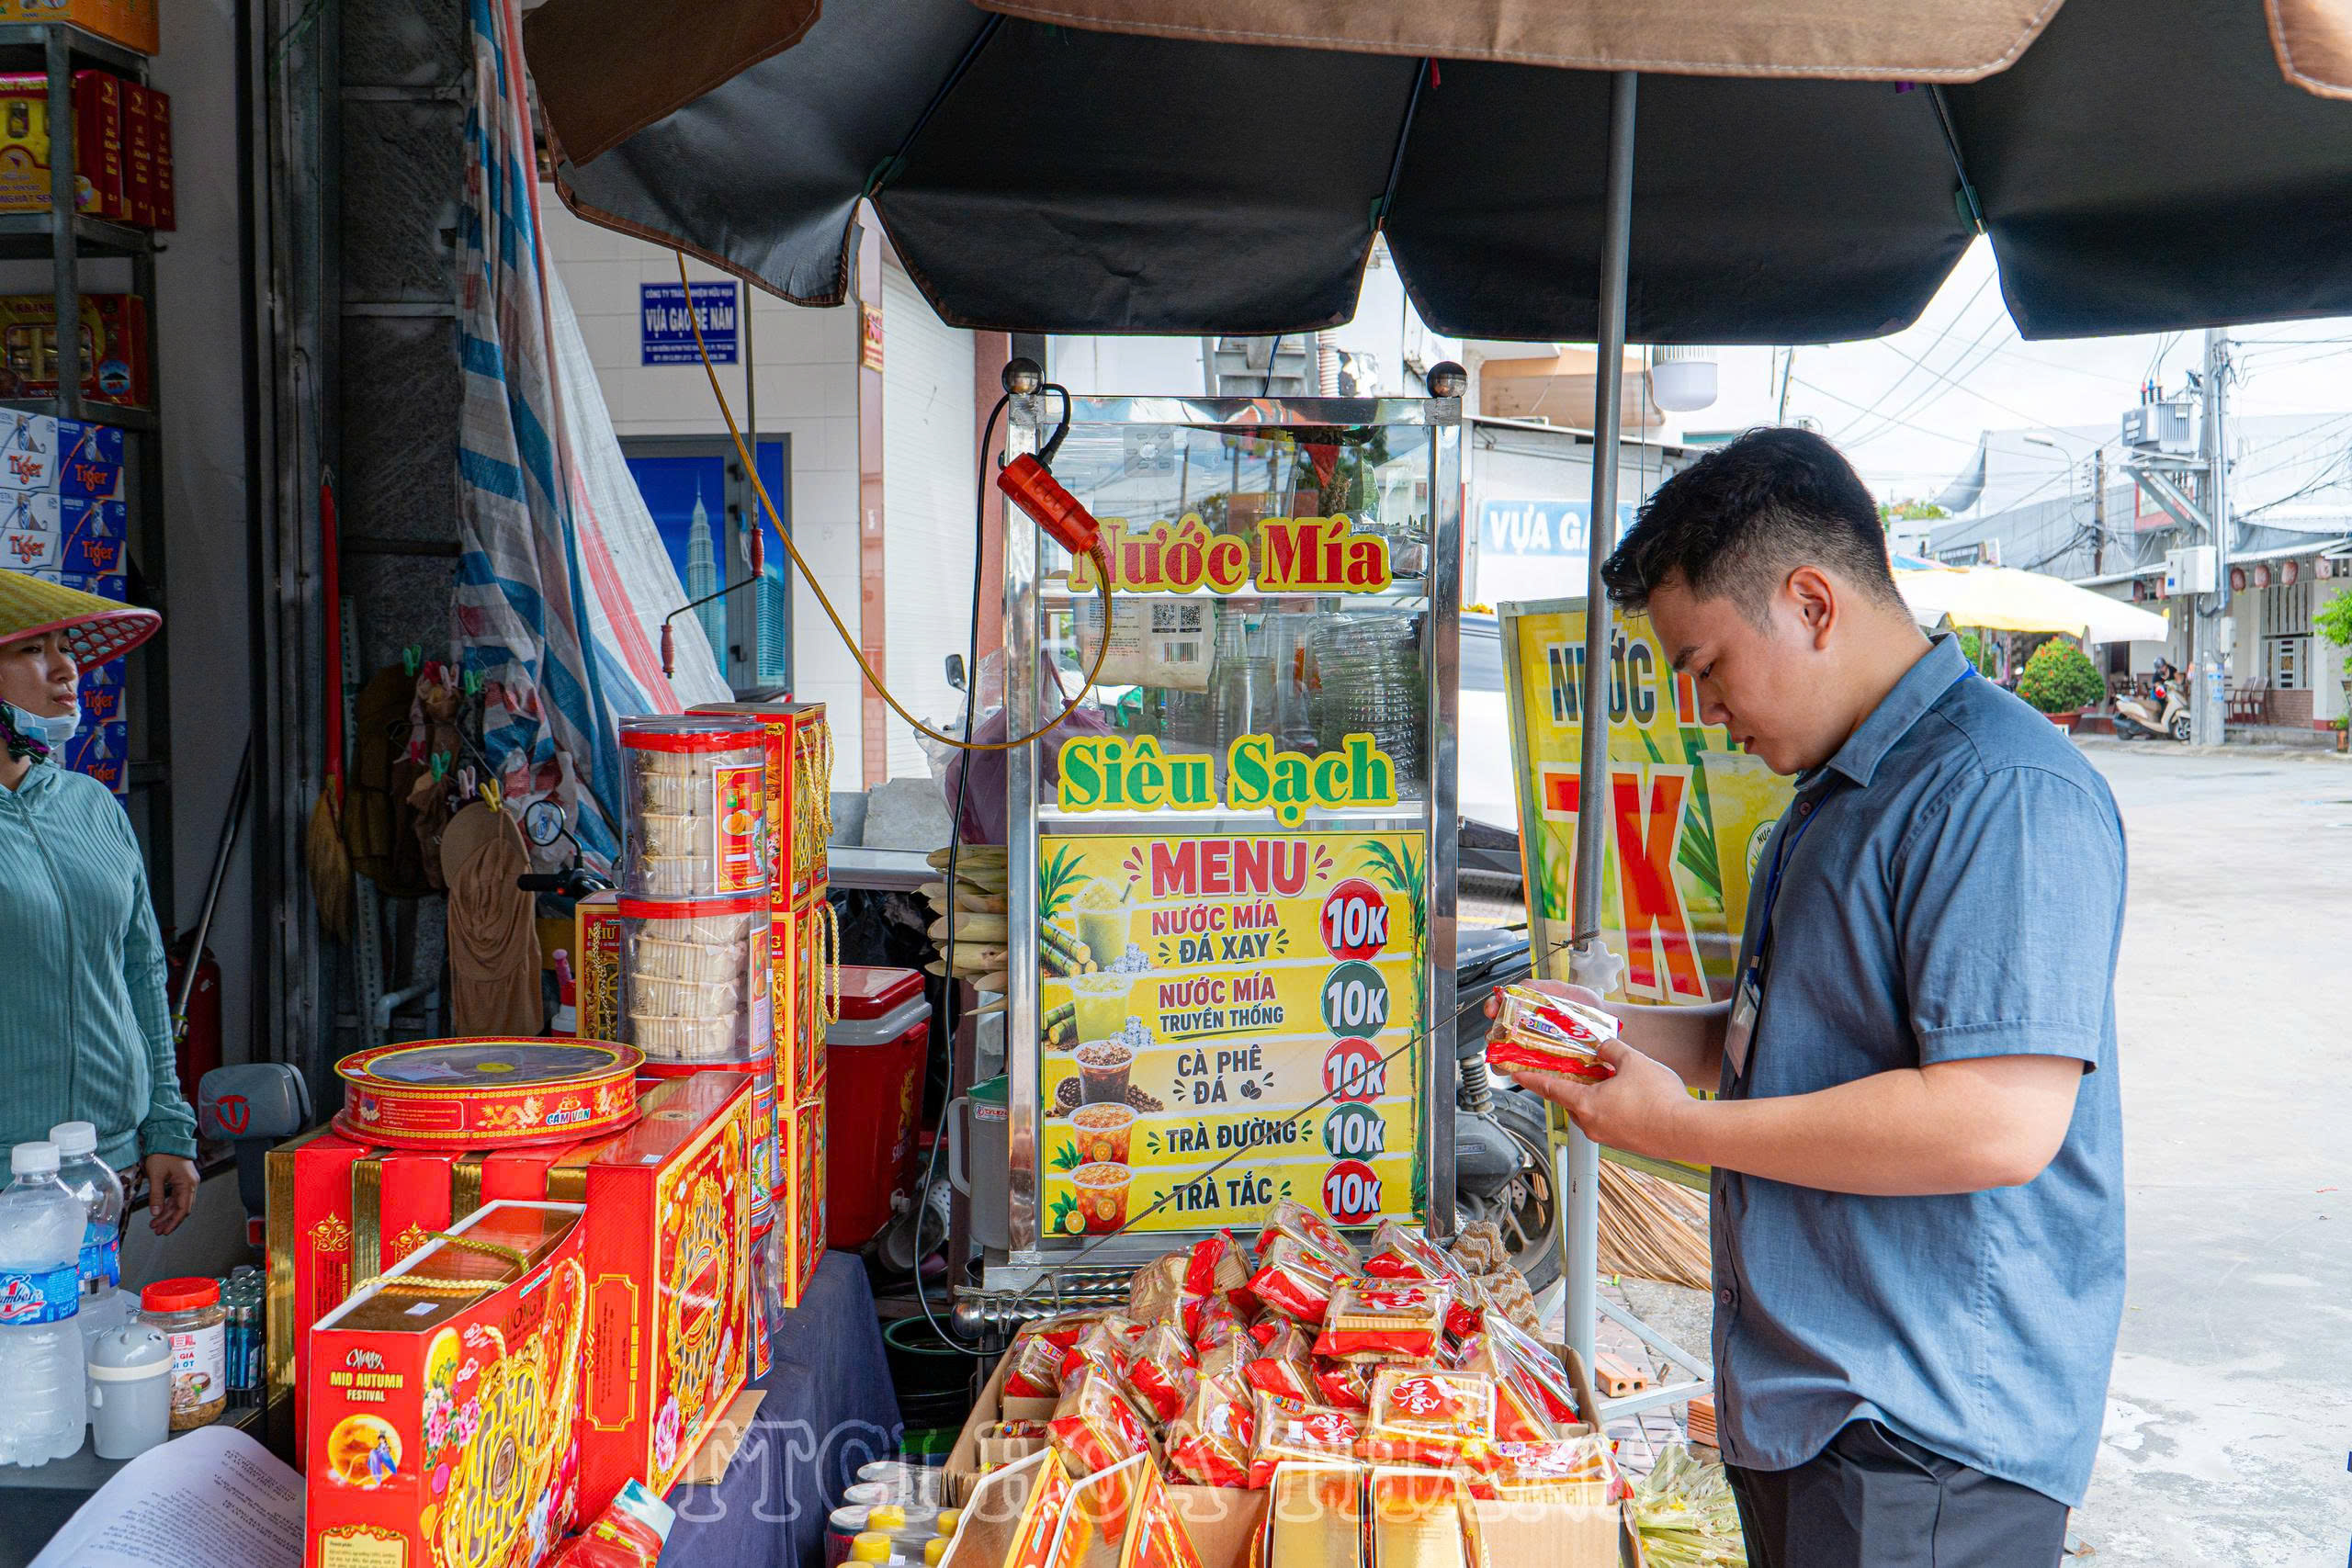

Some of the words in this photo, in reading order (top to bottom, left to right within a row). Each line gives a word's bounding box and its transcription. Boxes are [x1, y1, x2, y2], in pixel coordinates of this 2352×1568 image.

[8, 455, 44, 484] Tiger
[74, 464, 107, 491] Tiger
[1489, 504, 1551, 555] VỰA
[9, 535, 45, 564] Tiger
[82, 540, 114, 567] Tiger
[1263, 521, 1385, 586] Mía
[84, 691, 114, 715] Tiger
[1064, 741, 1210, 807] Siêu
[1233, 740, 1396, 820] Sạch
[1151, 840, 1308, 897] MENU
[1152, 904, 1226, 936] NƯỚC
[1233, 899, 1279, 930] MÍA
[1328, 898, 1387, 949] 10K
[1179, 934, 1214, 964] ĐÁ
[1222, 933, 1272, 961] XAY
[1159, 978, 1226, 1009] NƯỚC
[1232, 973, 1276, 1002] MÍA
[1328, 980, 1385, 1031] 10K
[1159, 1007, 1225, 1033] TRUYỀN
[1229, 1002, 1283, 1028] THỐNG
[1178, 1050, 1208, 1077] CÀ
[1217, 1044, 1262, 1074] PHÊ
[1329, 1052, 1384, 1099] 10K
[1194, 1077, 1227, 1105] ĐÁ
[1166, 1126, 1210, 1154] TRÀ
[1216, 1118, 1297, 1149] ĐƯỜNG
[1329, 1114, 1385, 1156] 10K
[1173, 1182, 1219, 1211] TRÀ
[1226, 1171, 1272, 1205] TẮC
[1328, 1174, 1382, 1215] 10K
[330, 1371, 353, 1387] MID
[356, 1372, 403, 1389] AUTUMN
[346, 1389, 386, 1402] FESTIVAL
